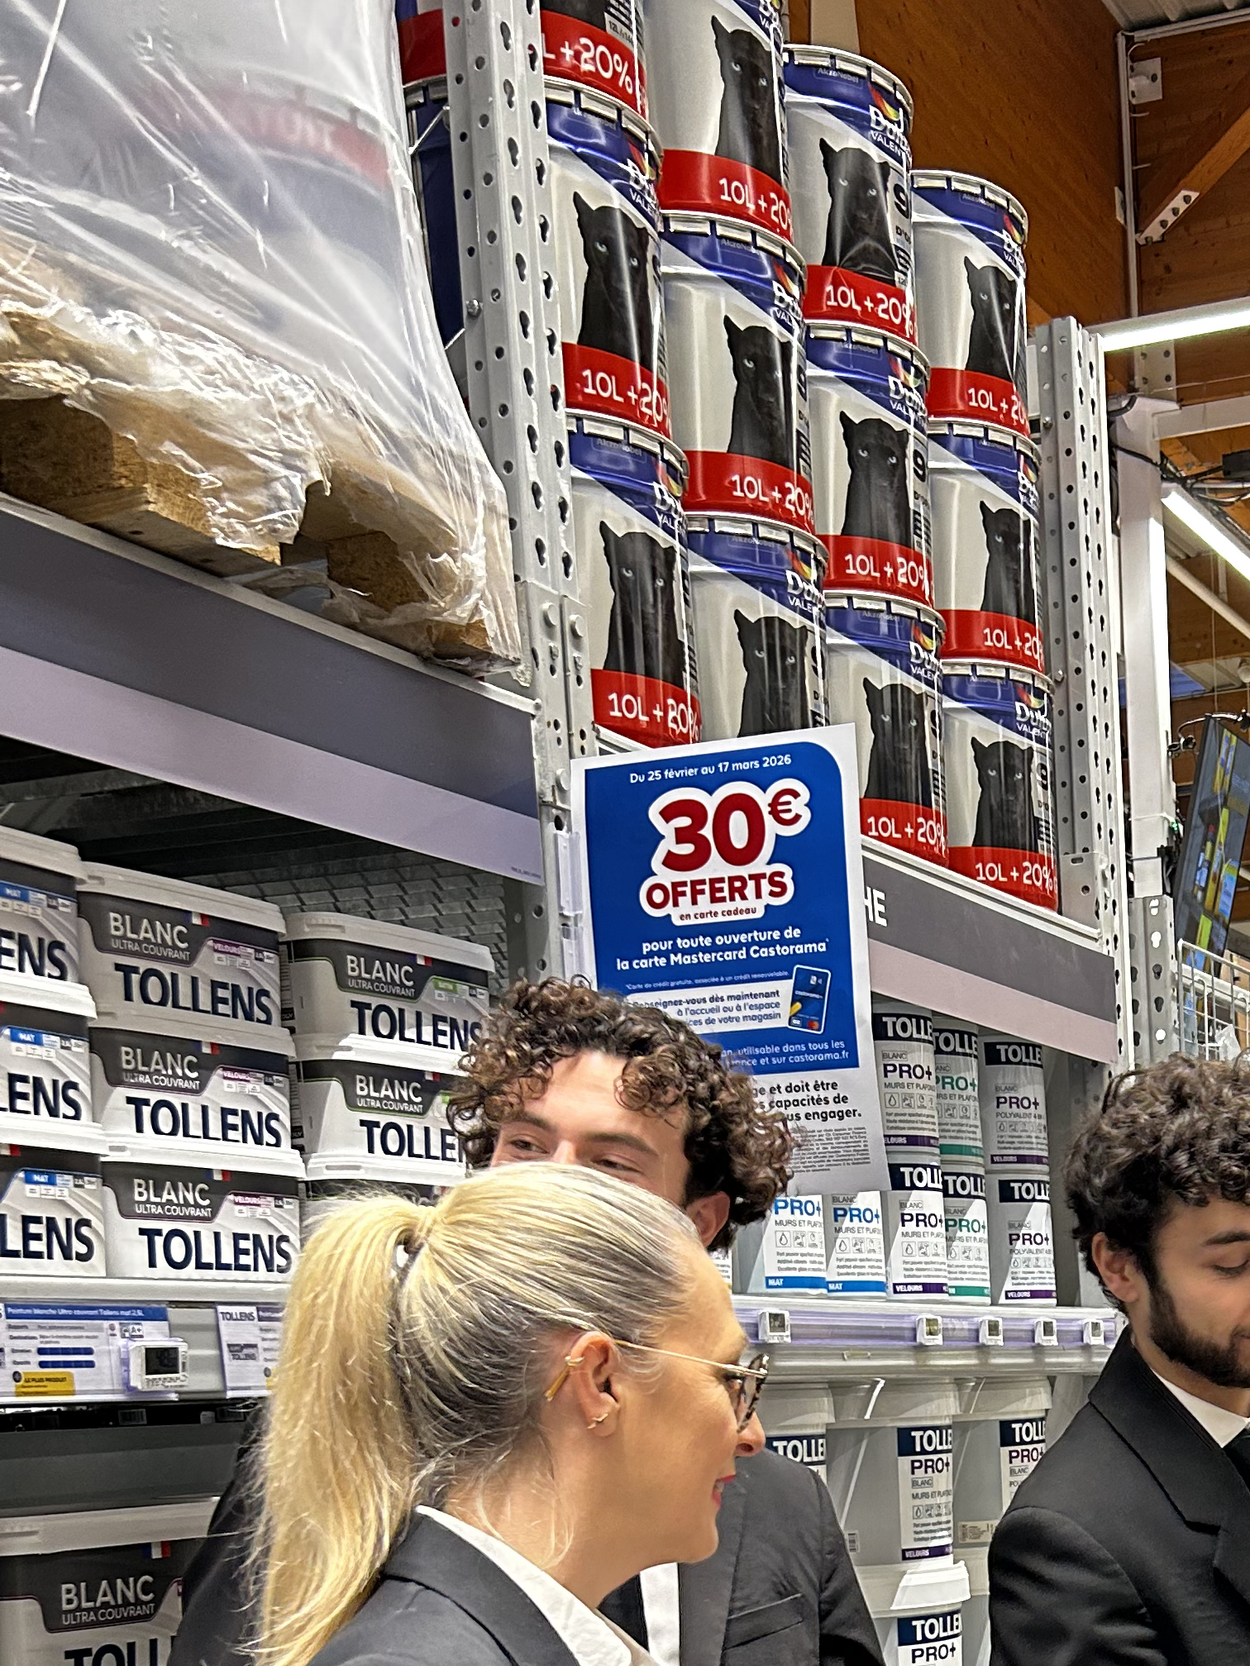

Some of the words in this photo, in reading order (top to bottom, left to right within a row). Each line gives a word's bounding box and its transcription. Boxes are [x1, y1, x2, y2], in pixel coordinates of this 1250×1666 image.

[579, 38, 634, 95] 20%
[719, 178, 756, 207] 10L
[826, 287, 862, 314] 10L
[582, 369, 623, 402] 10L
[968, 388, 996, 411] 10L
[731, 474, 768, 502] 10L
[846, 555, 880, 577] 10L
[984, 628, 1013, 647] 10L
[609, 693, 649, 720] 10L
[630, 773, 645, 783] Du
[648, 770, 662, 781] 25
[664, 767, 698, 779] février
[701, 765, 715, 775] au
[718, 762, 729, 772] 17
[732, 760, 760, 771] mars
[762, 755, 792, 767] 2026
[659, 788, 802, 872] 30€
[868, 817, 901, 838] 10L
[976, 863, 1004, 882] 10L
[1023, 864, 1054, 892] 20%
[646, 871, 788, 910] OFFERTS
[679, 913, 691, 921] en
[694, 910, 718, 919] carte
[721, 906, 757, 917] cadeau
[109, 912, 188, 949] BLANC
[642, 939, 673, 955] pour
[677, 934, 712, 948] toute
[715, 929, 780, 945] ouverture
[784, 926, 801, 939] de
[0, 930, 68, 981] ENS
[112, 938, 140, 952] ULTRA
[142, 944, 191, 961] COUVRANT
[616, 958, 629, 970] la
[632, 954, 667, 968] carte
[670, 946, 747, 965] Mastercard
[346, 955, 414, 986] BLANC
[114, 963, 273, 1025] TOLLENS
[348, 979, 372, 991] ULTRA
[374, 983, 415, 998] COUVRANT
[709, 992, 725, 1003] dès
[727, 990, 780, 1002] maintenant
[677, 1008, 683, 1016] à
[685, 1005, 720, 1016] l'accueil
[737, 1003, 742, 1011] à
[743, 1001, 781, 1014] l'espace
[705, 1015, 716, 1024] de
[718, 1014, 740, 1023] votre
[742, 1011, 781, 1025] magasin
[350, 1000, 482, 1051] TOLLENS
[882, 1016, 933, 1040] TOLLE
[738, 1044, 780, 1055] utilisable
[782, 1043, 806, 1053] dans
[808, 1041, 829, 1051] tous
[832, 1040, 845, 1049] les
[760, 1057, 771, 1065] et
[788, 1050, 849, 1063] castorama.fr
[996, 1045, 1041, 1064] TOLLE
[120, 1046, 199, 1078] BLANC
[883, 1064, 932, 1080] PRO+
[123, 1072, 151, 1084] ULTRA
[153, 1075, 200, 1090] COUVRANT
[356, 1075, 422, 1103] BLANC
[769, 1083, 782, 1095] et
[785, 1080, 811, 1093] doit
[813, 1079, 838, 1091] être
[357, 1098, 381, 1108] ULTRA
[382, 1101, 423, 1113] COUVRANT
[768, 1094, 830, 1111] capacités
[833, 1093, 849, 1104] de
[996, 1096, 1039, 1110] PRO+
[126, 1096, 281, 1147] TOLLENS
[804, 1108, 862, 1123] engager.
[133, 1179, 210, 1206] BLANC
[135, 1204, 163, 1215] ULTRA
[164, 1205, 212, 1218] COUVRANT
[774, 1199, 821, 1216] PRO+
[833, 1207, 880, 1224] PRO+
[901, 1213, 943, 1228] PRO+
[945, 1219, 986, 1233] PRO+
[0, 1214, 94, 1262] LENS
[1009, 1233, 1049, 1245] PRO+
[139, 1228, 292, 1273] TOLLENS
[221, 1312, 255, 1321] TOLLENS
[911, 1457, 950, 1475] PRO+
[912, 1479, 932, 1487] BLANC
[912, 1491, 928, 1500] MURS
[61, 1575, 154, 1611] BLANC
[62, 1610, 96, 1625] ULTRA
[98, 1604, 154, 1621] COUVRANT
[912, 1613, 961, 1641] TOLLE
[912, 1642, 956, 1664] PRO+
